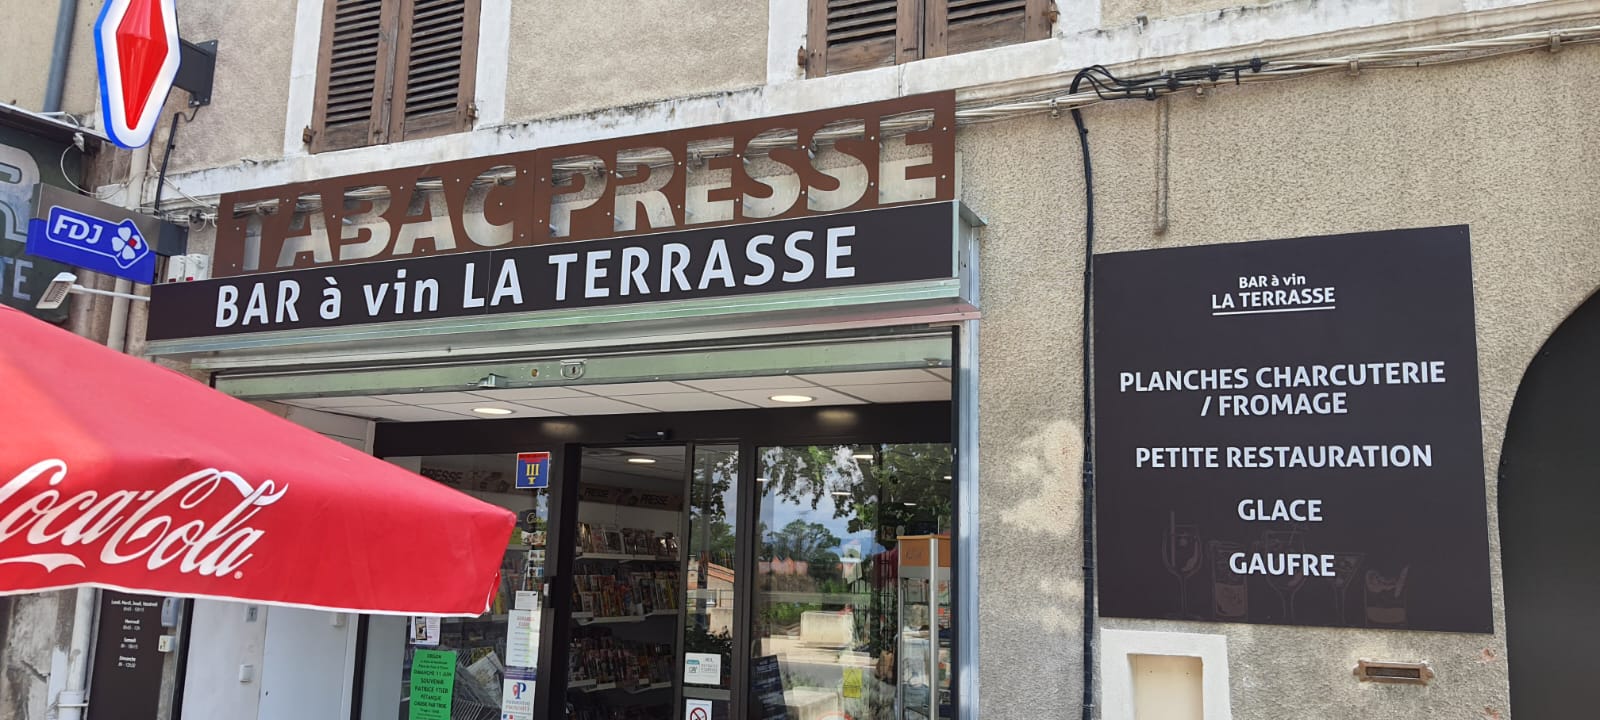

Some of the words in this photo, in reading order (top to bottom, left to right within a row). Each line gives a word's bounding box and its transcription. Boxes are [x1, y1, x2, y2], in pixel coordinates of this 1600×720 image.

[232, 165, 517, 272] TABAC
[549, 108, 937, 238] PRESSE
[53, 214, 104, 244] FDJ
[215, 279, 301, 328] BAR
[319, 276, 342, 321] à
[363, 268, 439, 317] vin
[463, 258, 524, 309] LA
[548, 225, 856, 301] TERRASSE
[1238, 274, 1268, 289] BAR
[1270, 273, 1279, 287] à
[1282, 272, 1306, 286] vin
[1211, 292, 1235, 310] LA
[1238, 287, 1336, 308] TERRASSE
[1119, 367, 1249, 393] PLANCHES
[1255, 360, 1446, 388] CHARCUTERIE
[1200, 395, 1212, 417] /
[1218, 392, 1348, 417] FROMAGE
[1135, 447, 1219, 469] PETITE
[1226, 444, 1433, 469] RESTAURATION
[1237, 498, 1323, 522] GLACE
[1228, 552, 1336, 577] GAUFRE
